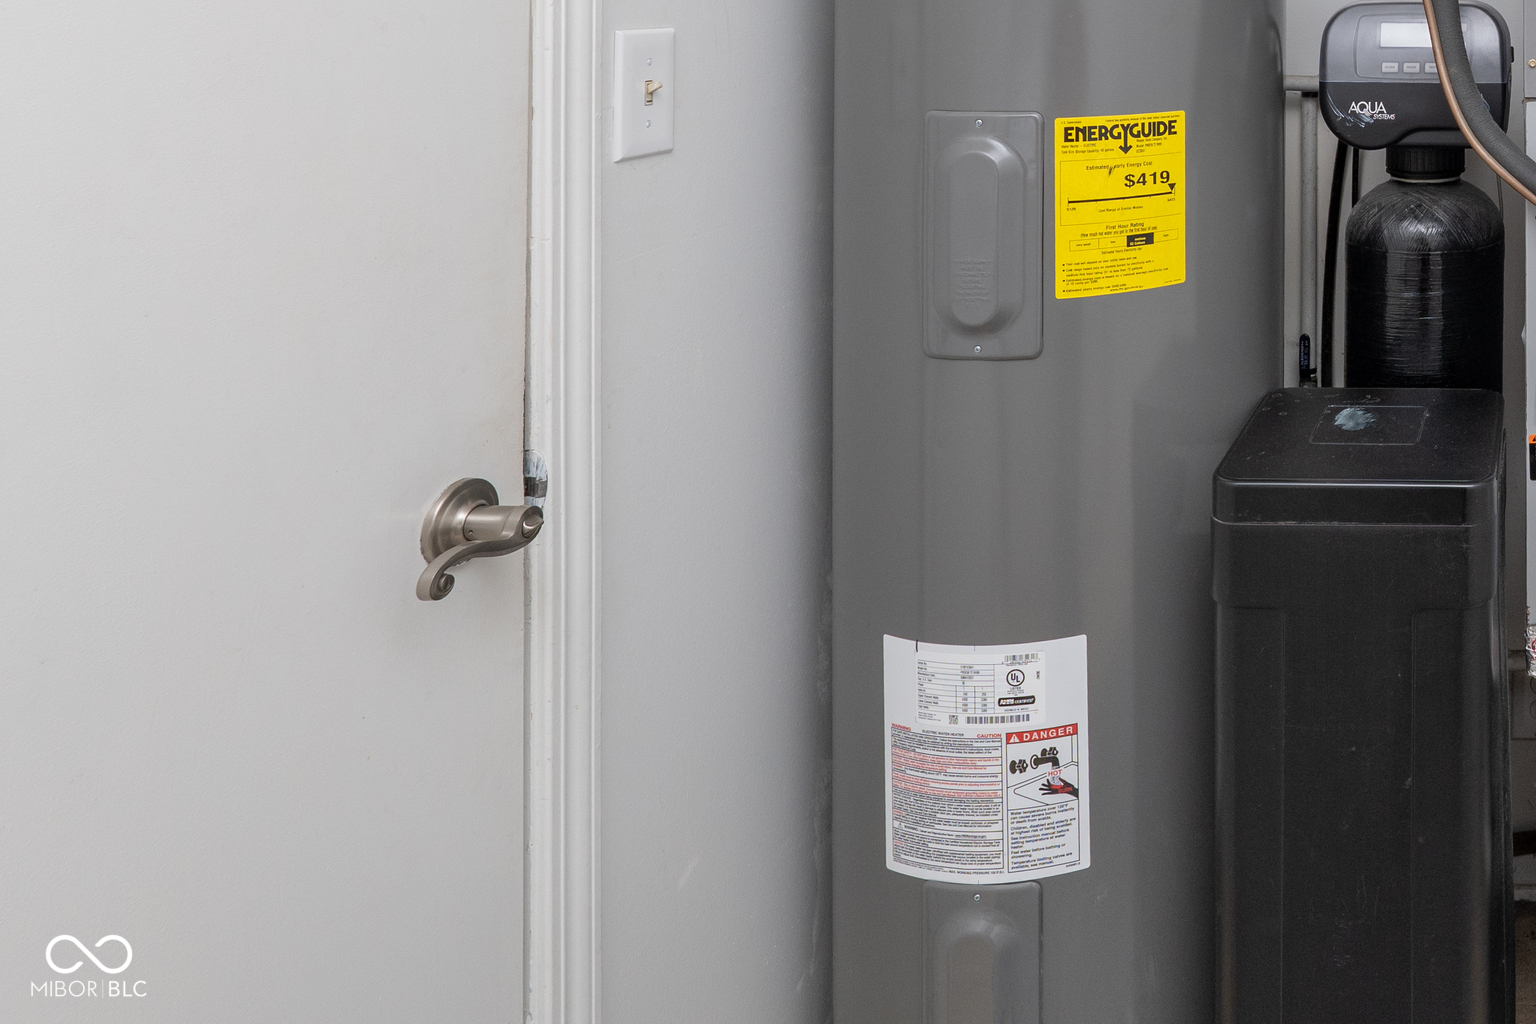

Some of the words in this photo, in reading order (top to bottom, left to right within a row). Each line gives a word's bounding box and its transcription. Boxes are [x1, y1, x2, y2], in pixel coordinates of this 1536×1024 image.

[1348, 101, 1387, 114] AQUA
[1063, 120, 1177, 143] ENERGYGUIDE
[1124, 170, 1170, 188] $419
[1010, 673, 1021, 683] UL
[1023, 726, 1073, 741] DANGER
[1048, 769, 1062, 777] HOT
